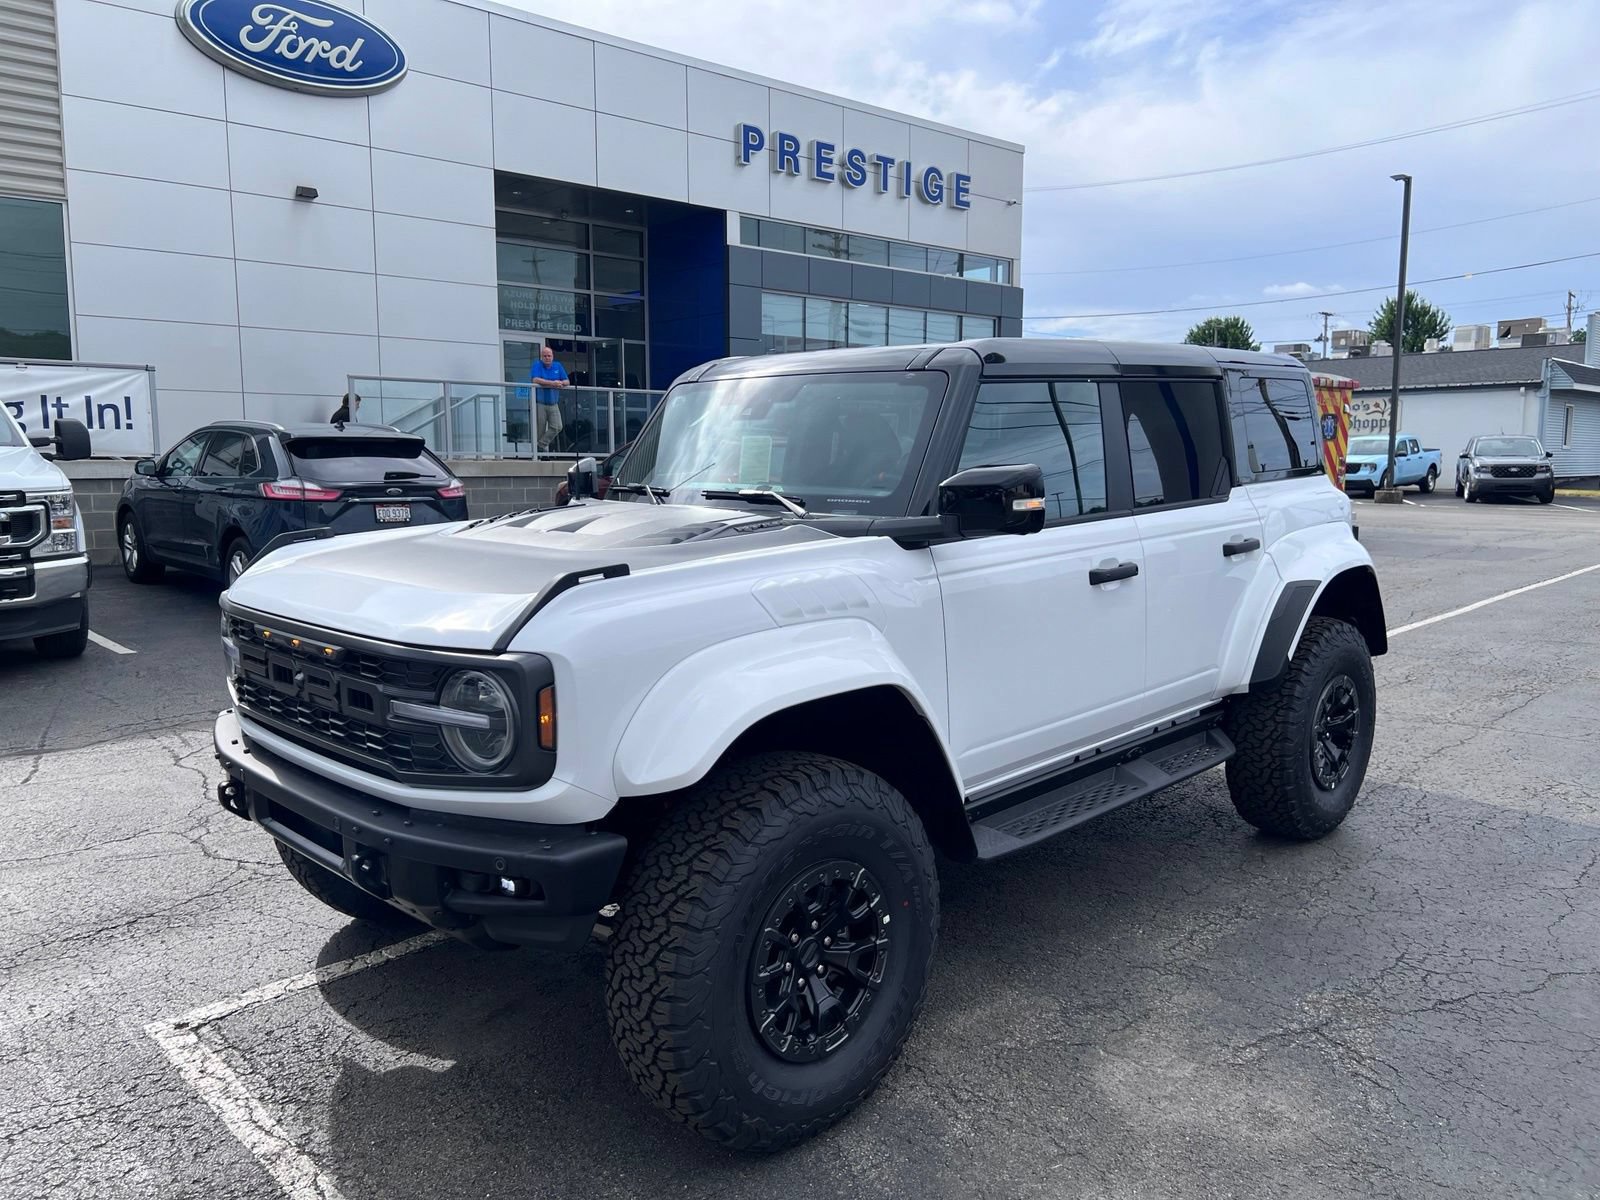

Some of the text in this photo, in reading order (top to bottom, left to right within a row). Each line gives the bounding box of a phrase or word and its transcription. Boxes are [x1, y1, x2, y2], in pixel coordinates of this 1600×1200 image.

[239, 3, 365, 73] Ford
[738, 122, 972, 210] PRESTIGE
[504, 318, 582, 333] PRESTIGE FORD
[510, 300, 557, 312] HOLDINGS
[40, 394, 69, 429] It
[84, 395, 133, 430] In!
[238, 645, 383, 726] FORD
